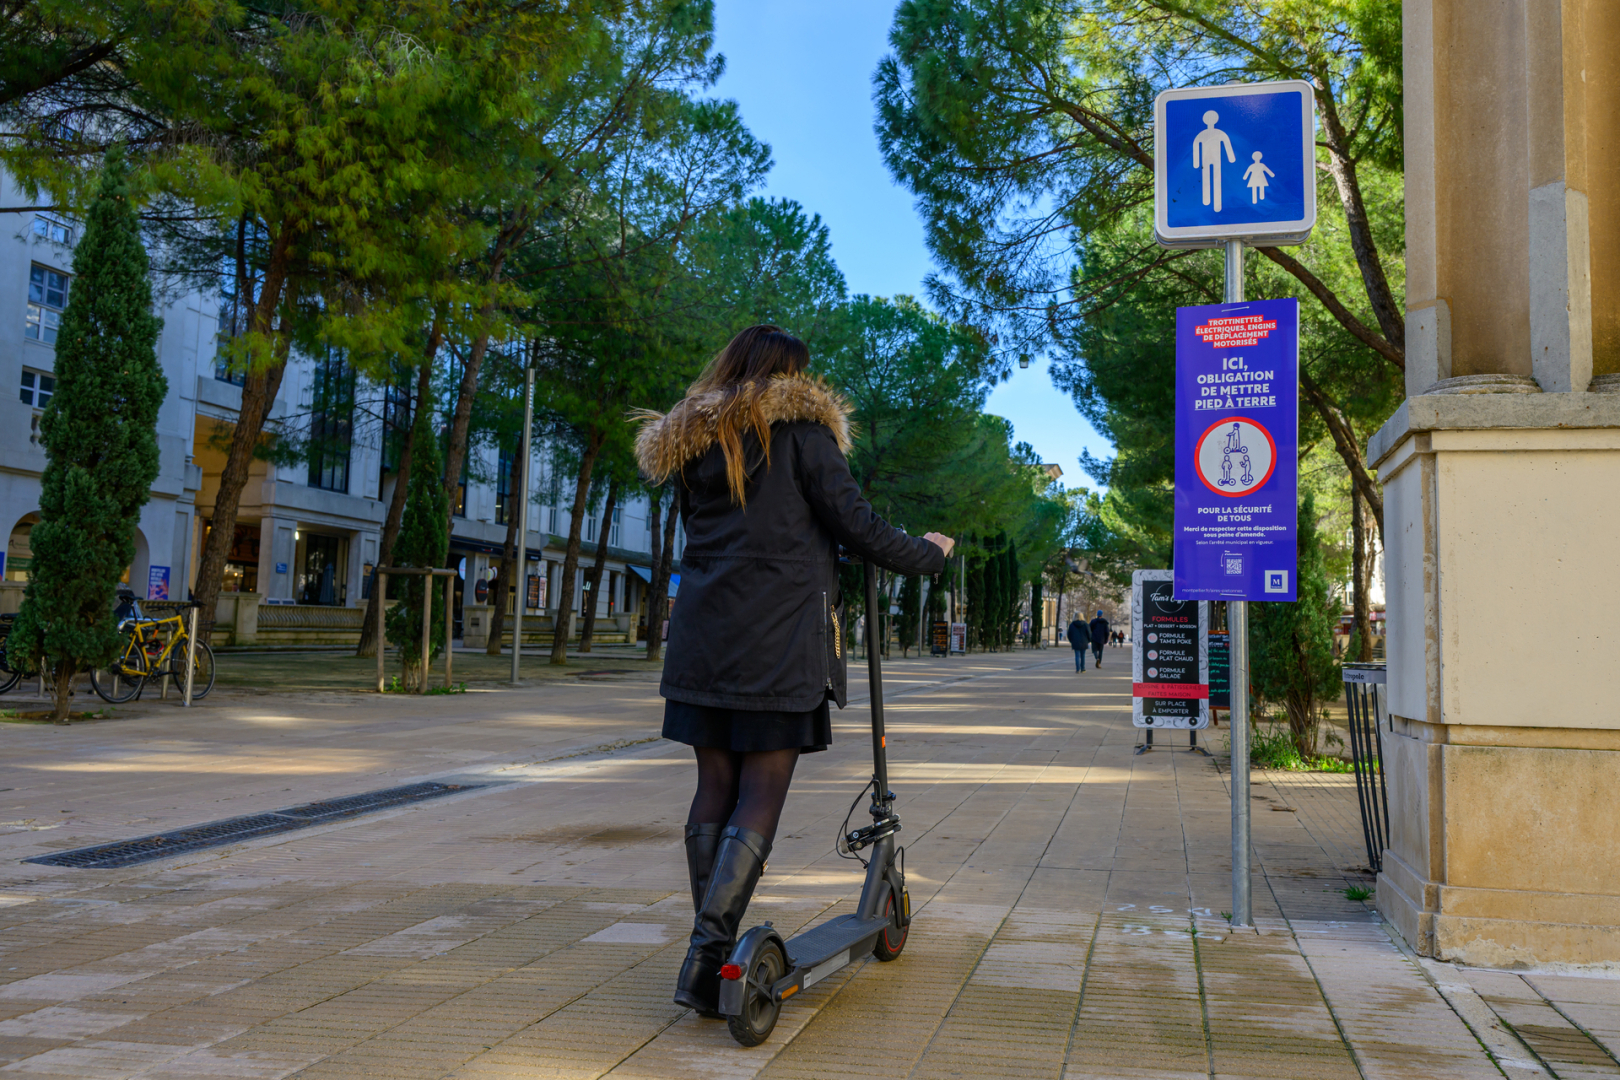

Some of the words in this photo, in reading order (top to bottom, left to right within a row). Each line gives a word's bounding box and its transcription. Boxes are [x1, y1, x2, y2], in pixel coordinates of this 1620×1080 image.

[1208, 316, 1263, 326] TROTTINETTES
[1248, 322, 1276, 330] ENGINS
[1214, 330, 1268, 340] DÉPLACEMENT
[1213, 337, 1257, 348] MOTORISÉS
[1222, 357, 1248, 371] ICI,
[1196, 370, 1274, 384] OBLIGATION
[1201, 386, 1217, 396] DE
[1220, 383, 1270, 396] METTRE
[1195, 398, 1222, 409] PIED
[1225, 395, 1234, 408] À
[1236, 396, 1276, 407] TERRE
[1233, 504, 1272, 514] SÉCURITÉ
[1150, 593, 1170, 602] Tam's
